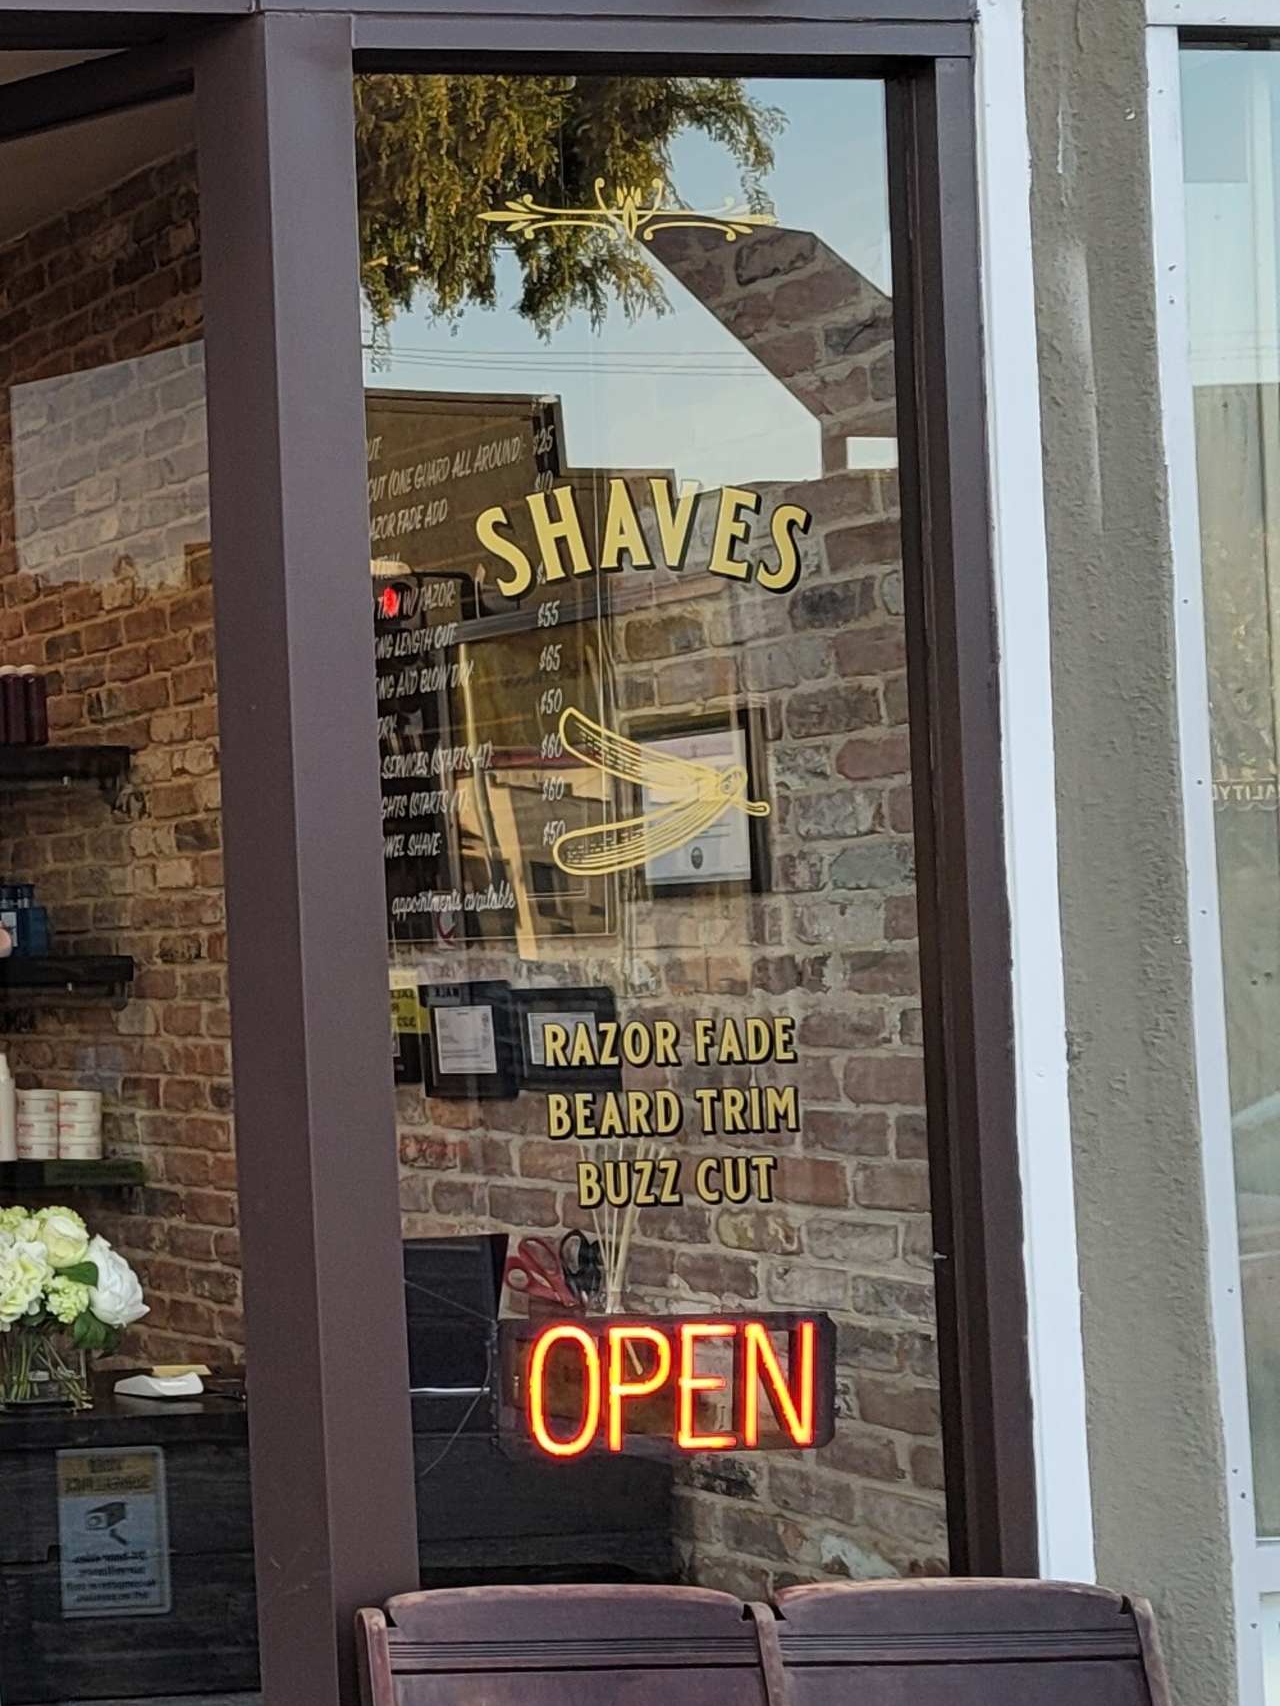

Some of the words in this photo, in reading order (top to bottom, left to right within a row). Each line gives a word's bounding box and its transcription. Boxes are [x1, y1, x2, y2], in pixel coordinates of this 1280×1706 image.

[414, 456, 450, 489] GUARD
[452, 447, 473, 479] ALL
[396, 504, 424, 534] FADE
[425, 497, 448, 527] ADD
[475, 476, 813, 597] SHAVES
[394, 626, 432, 657] LENGTH
[538, 600, 561, 628] $55
[396, 668, 418, 698] AND
[419, 662, 451, 694] BLOW
[539, 644, 562, 672] $65
[541, 688, 563, 715] $50
[382, 750, 431, 780] SERVICES
[541, 733, 563, 760] $60
[542, 776, 565, 802] $60
[543, 820, 566, 846] $50
[392, 888, 462, 922] appointments
[464, 880, 516, 912] available
[544, 1020, 682, 1068] RAZOR
[695, 1016, 799, 1065] FADE
[547, 1089, 684, 1140] BEARD
[695, 1085, 801, 1135] TRIM
[576, 1157, 683, 1208] BUZZ
[695, 1155, 778, 1204] CUT
[528, 1320, 816, 1458] OPEN
